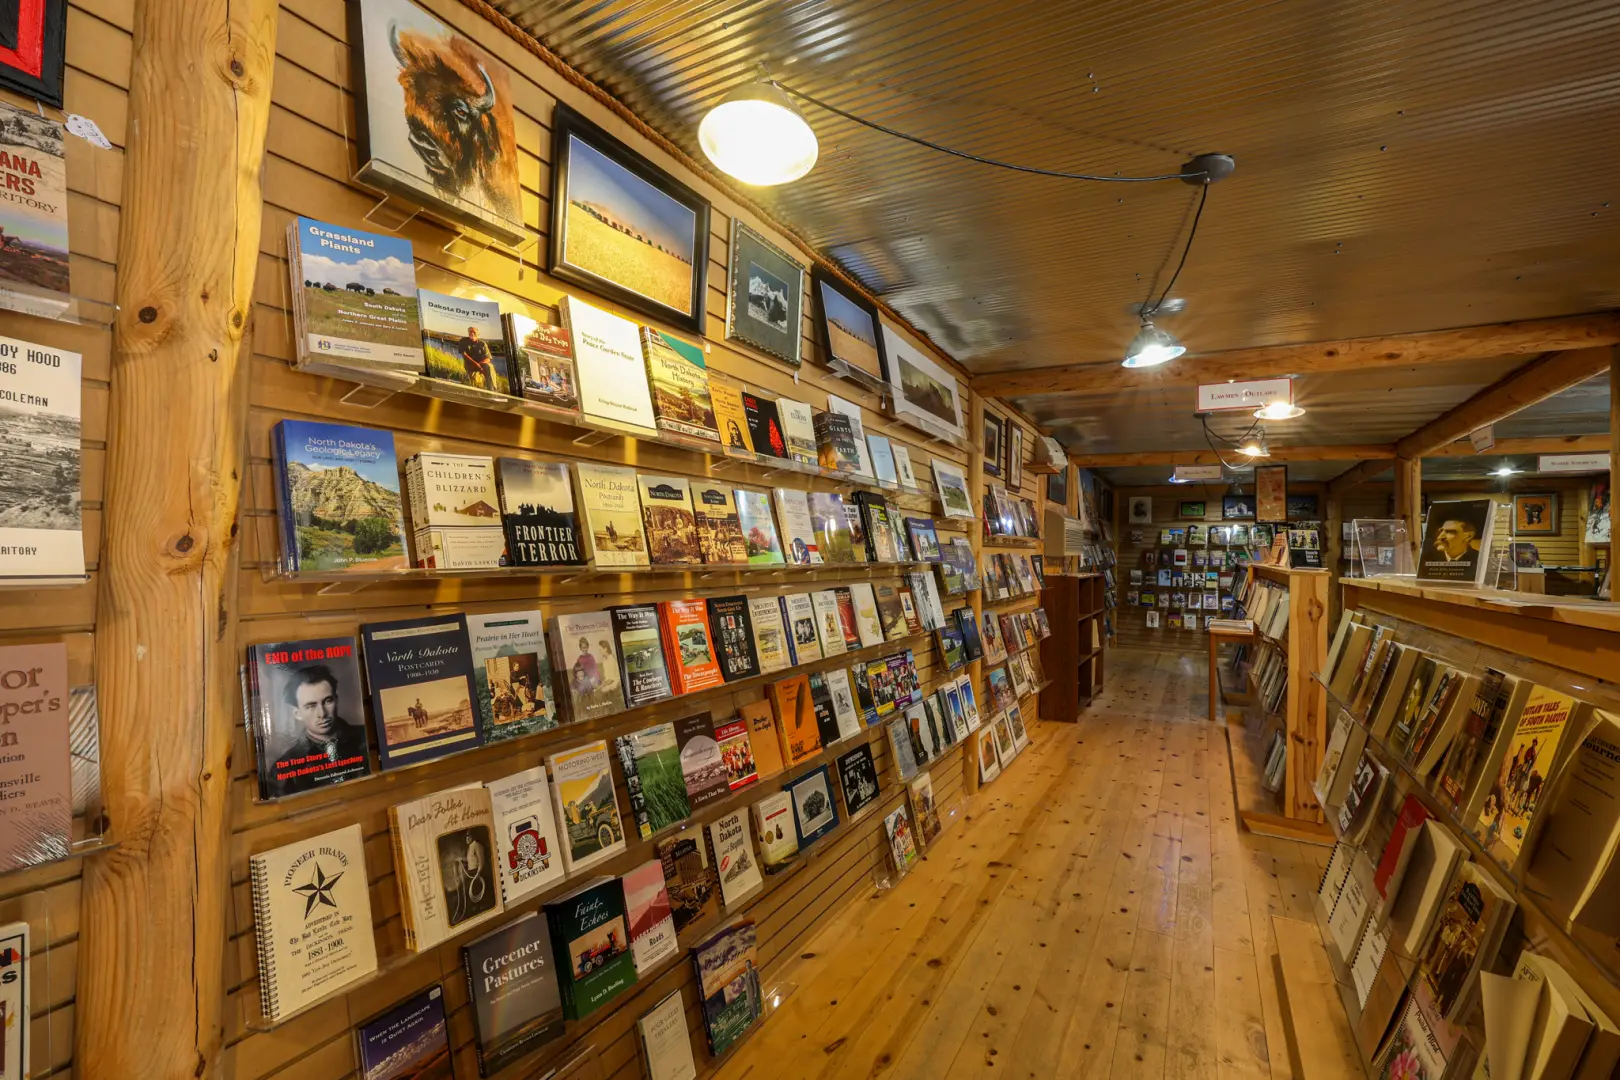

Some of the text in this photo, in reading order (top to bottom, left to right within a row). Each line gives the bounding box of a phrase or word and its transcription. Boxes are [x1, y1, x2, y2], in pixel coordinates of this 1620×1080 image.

[310, 226, 374, 248] Grassland
[320, 238, 362, 254] Plants
[338, 308, 408, 324] Northern Great Plains
[362, 300, 406, 314] South Dakota
[428, 302, 456, 314] Dakota
[456, 306, 472, 318] Day
[470, 310, 490, 320] Trips
[552, 336, 568, 348] Trips
[600, 344, 620, 358] Garden
[26, 348, 60, 368] HOOD
[660, 358, 702, 380] North Dakota
[672, 370, 696, 388] History
[0, 390, 48, 408] COLEMAN
[1210, 390, 1278, 400] LAWMEN OUTLAWS
[828, 424, 852, 434] GIANTS
[304, 444, 382, 460] Geologic Legacy
[308, 436, 376, 452] North Dakota's
[834, 446, 856, 454] EARTH
[426, 470, 492, 482] CHILDREN'S
[584, 478, 636, 492] North Dakota
[436, 484, 488, 494] BLIZZARD
[598, 492, 624, 502] Postcards
[650, 490, 682, 500] NORTH DAKOTA
[514, 524, 574, 544] FRONTIER
[334, 556, 348, 564] John
[516, 542, 578, 564] TERROR
[452, 560, 474, 568] DAVID
[616, 612, 628, 620] The
[628, 612, 640, 620] Way
[644, 610, 656, 618] Was
[476, 630, 540, 644] Prairie in Her Heart
[264, 650, 290, 666] END
[290, 648, 304, 662] of
[304, 648, 326, 662] the
[378, 644, 460, 664] North Dakota
[398, 658, 446, 674] POSTCARDS
[632, 678, 642, 688] The
[1522, 702, 1544, 718] OUTLAW
[1542, 700, 1562, 712] TALES
[1518, 710, 1568, 728] OF SOUTH DAKOTA
[274, 754, 324, 770] The True Story
[276, 768, 298, 782] North
[296, 764, 326, 778] Dakota's
[336, 754, 364, 768] Lynching
[558, 750, 606, 772] MOTORING WEST
[698, 794, 708, 804] Town
[708, 790, 718, 800] That
[406, 796, 464, 832] Dear Folks
[444, 814, 460, 830] At
[460, 806, 490, 822] Home
[718, 814, 742, 844] North Dakota
[284, 846, 350, 888] PIONEER BRANDS
[518, 864, 546, 882] DICKINSON
[574, 896, 604, 920] Faint
[578, 910, 610, 932] Echoes
[290, 948, 302, 956] THE
[304, 934, 334, 952] DICKINSON
[648, 930, 666, 948] Roads
[482, 940, 542, 974] Greener
[484, 954, 546, 994] Pastures
[368, 1004, 432, 1044] WHEN THE LANDSCAPE
[380, 1016, 424, 1046] IS QUIET AGAIN
